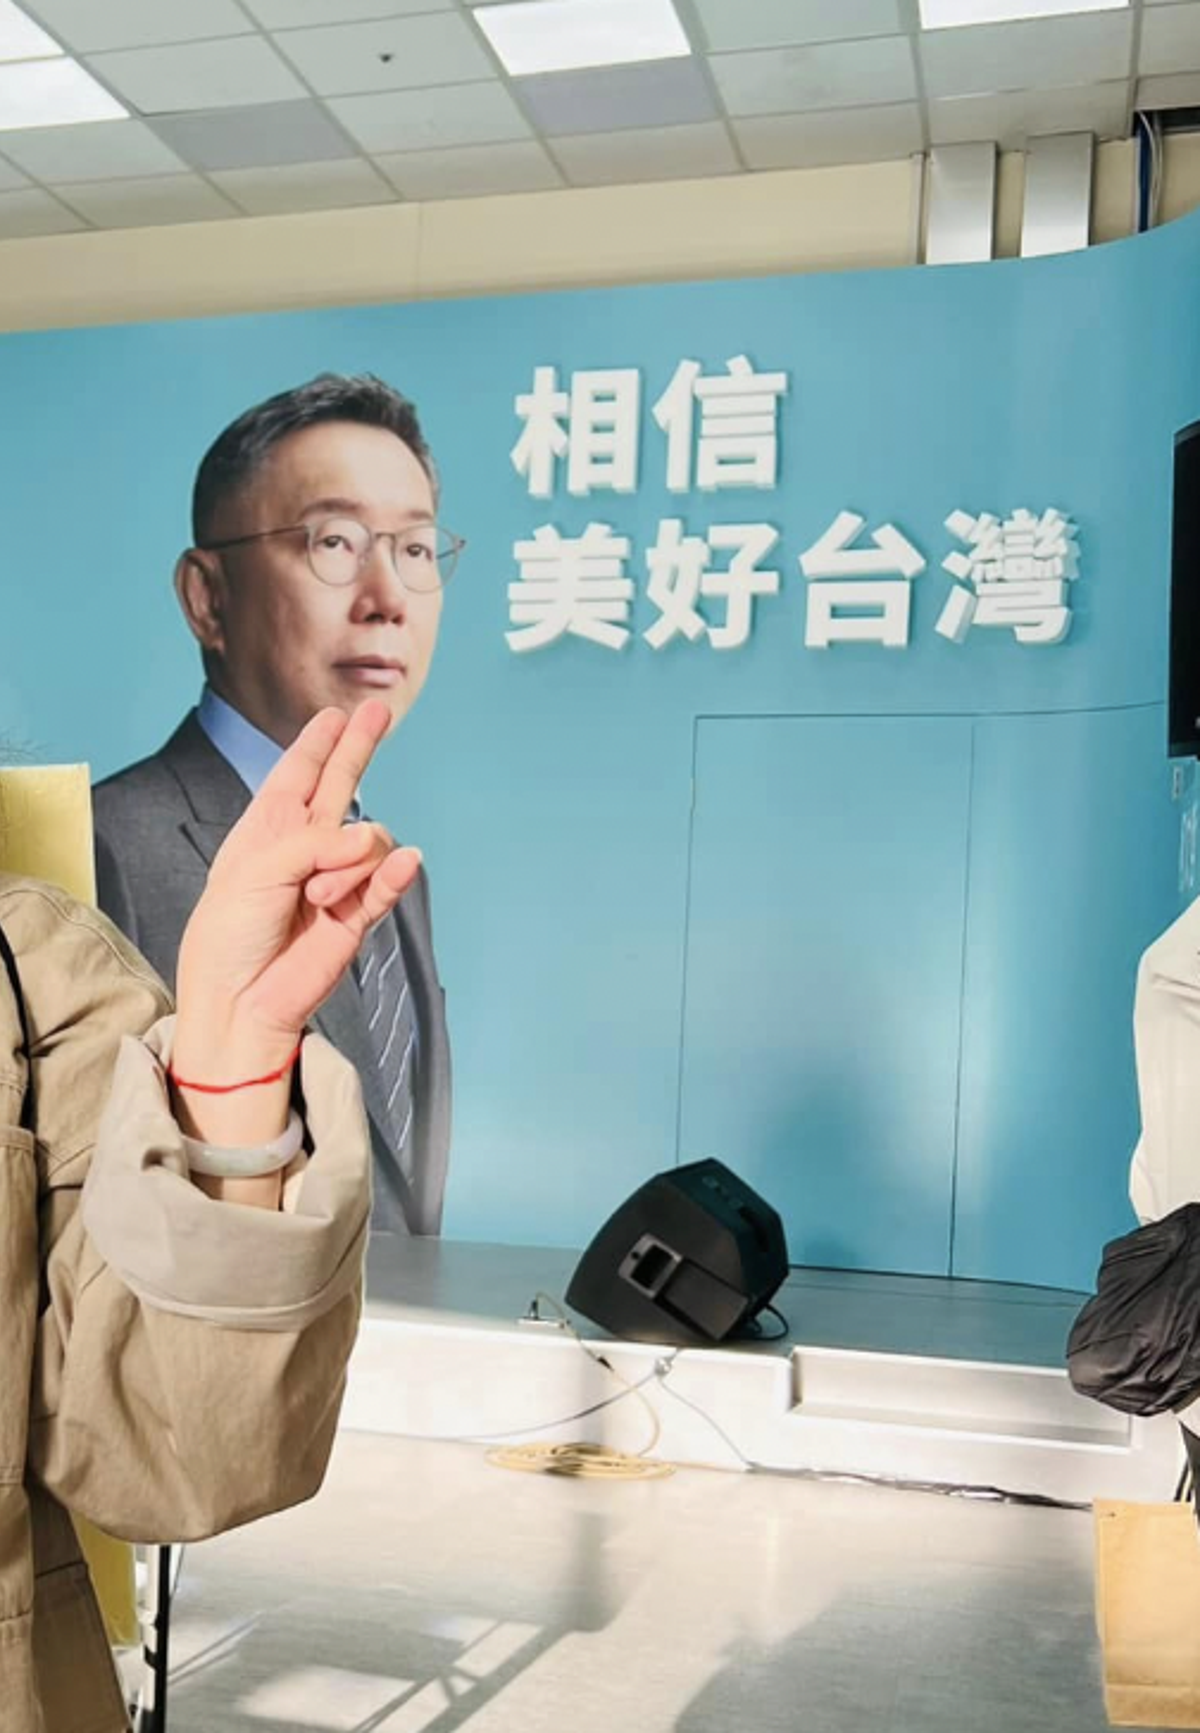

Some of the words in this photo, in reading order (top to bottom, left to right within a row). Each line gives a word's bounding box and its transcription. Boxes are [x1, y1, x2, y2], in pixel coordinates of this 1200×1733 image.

[510, 354, 788, 497] 相信
[504, 507, 1080, 652] 美好台灣
